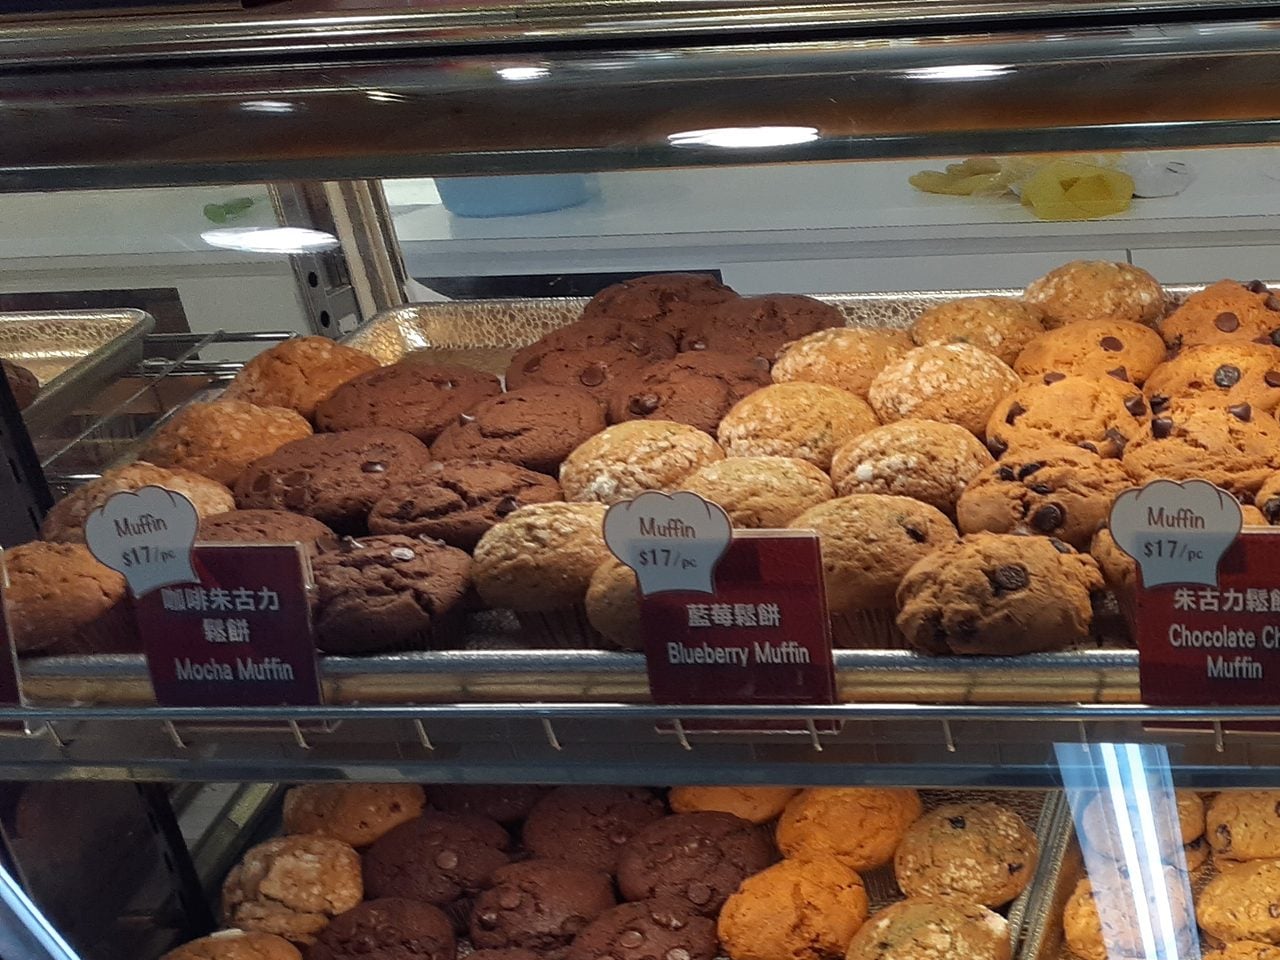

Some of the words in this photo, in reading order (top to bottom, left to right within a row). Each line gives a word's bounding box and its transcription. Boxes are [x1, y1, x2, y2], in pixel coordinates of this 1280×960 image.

[113, 513, 168, 537] Muffin
[639, 517, 696, 539] Muffin
[1147, 506, 1205, 530] Muffin
[639, 549, 697, 570] $17/pc
[1143, 539, 1204, 562] $17/pc
[160, 586, 280, 611] 咖啡朱古力
[687, 603, 781, 627] 藍莓鬆餅
[203, 618, 250, 642] 鬆餅
[1168, 624, 1256, 648] Chocolate
[667, 641, 749, 667] Blueberry
[753, 641, 810, 664] Muffin
[174, 657, 234, 681] Mocha
[237, 657, 295, 681] Muffin
[1207, 655, 1263, 679] Muffin
